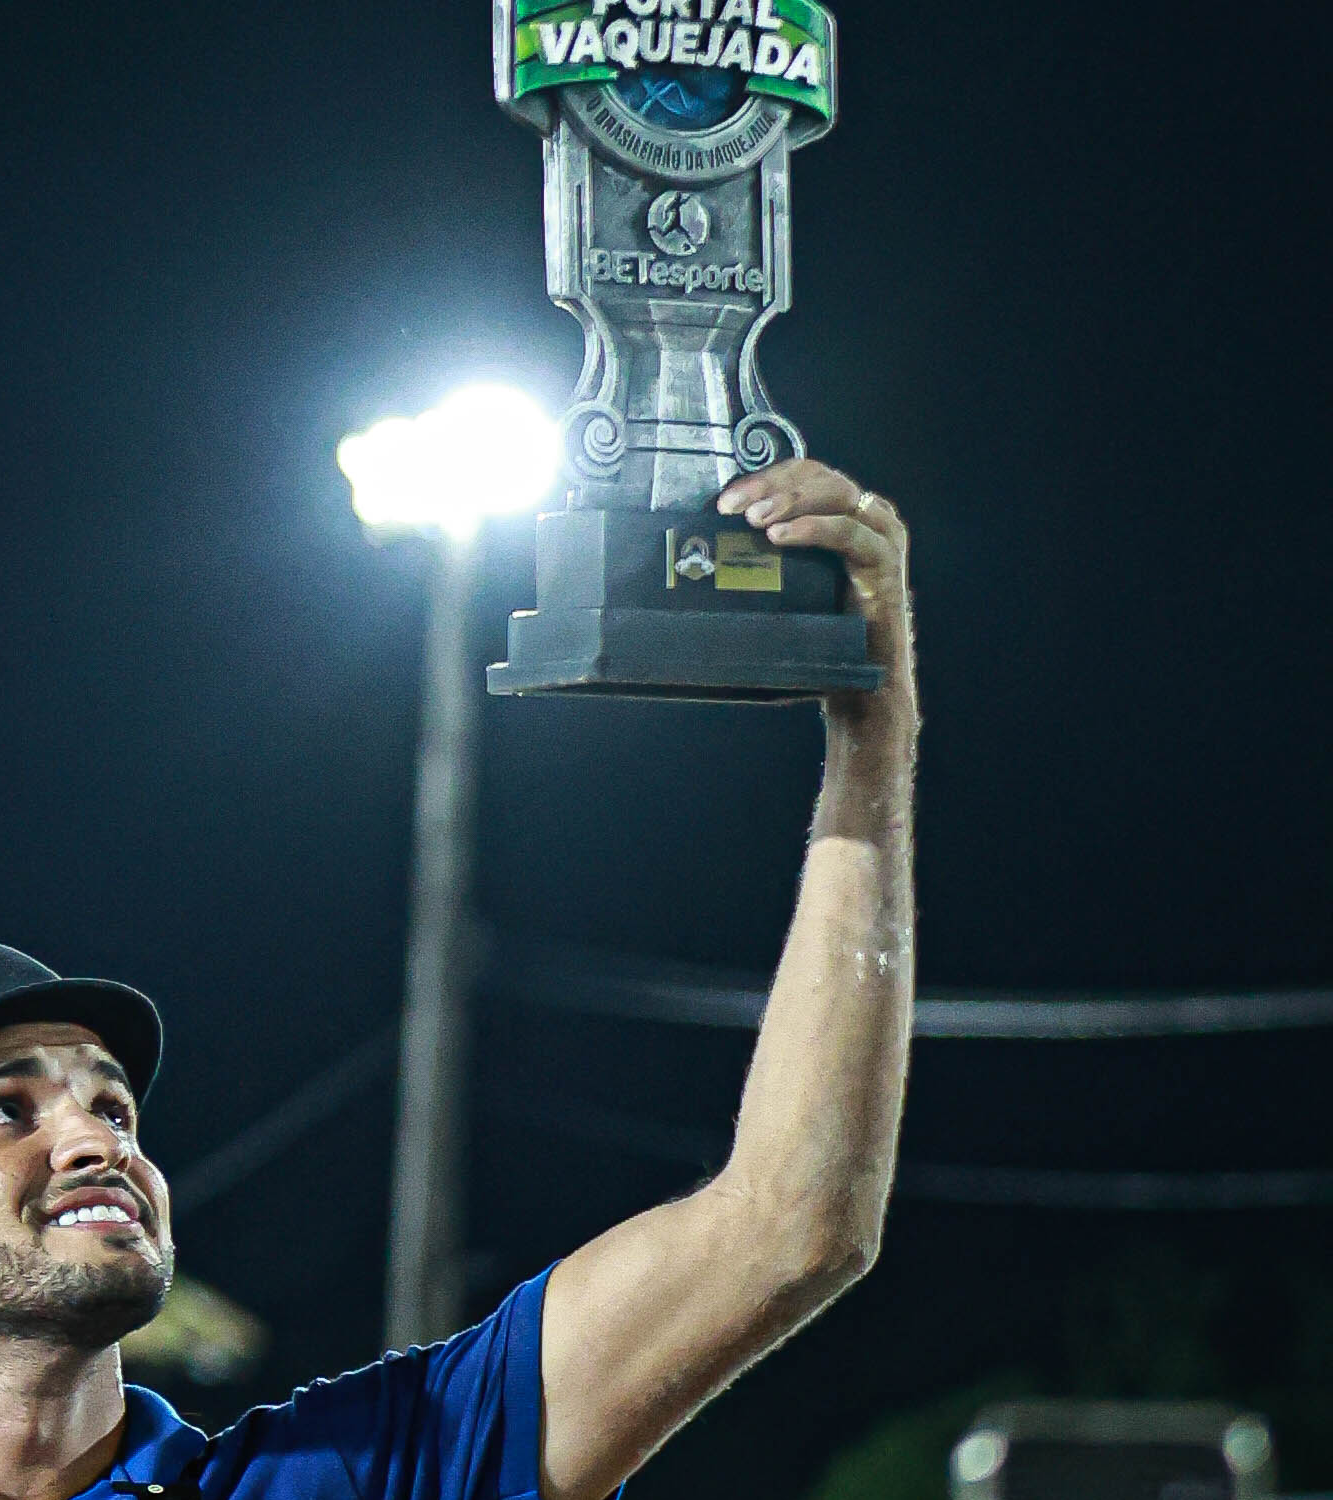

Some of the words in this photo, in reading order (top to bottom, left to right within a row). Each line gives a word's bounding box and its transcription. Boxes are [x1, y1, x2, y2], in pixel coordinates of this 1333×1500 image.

[539, 21, 822, 87] VAQUEJADA
[685, 150, 704, 171] DA
[588, 248, 766, 295] BETesporte
